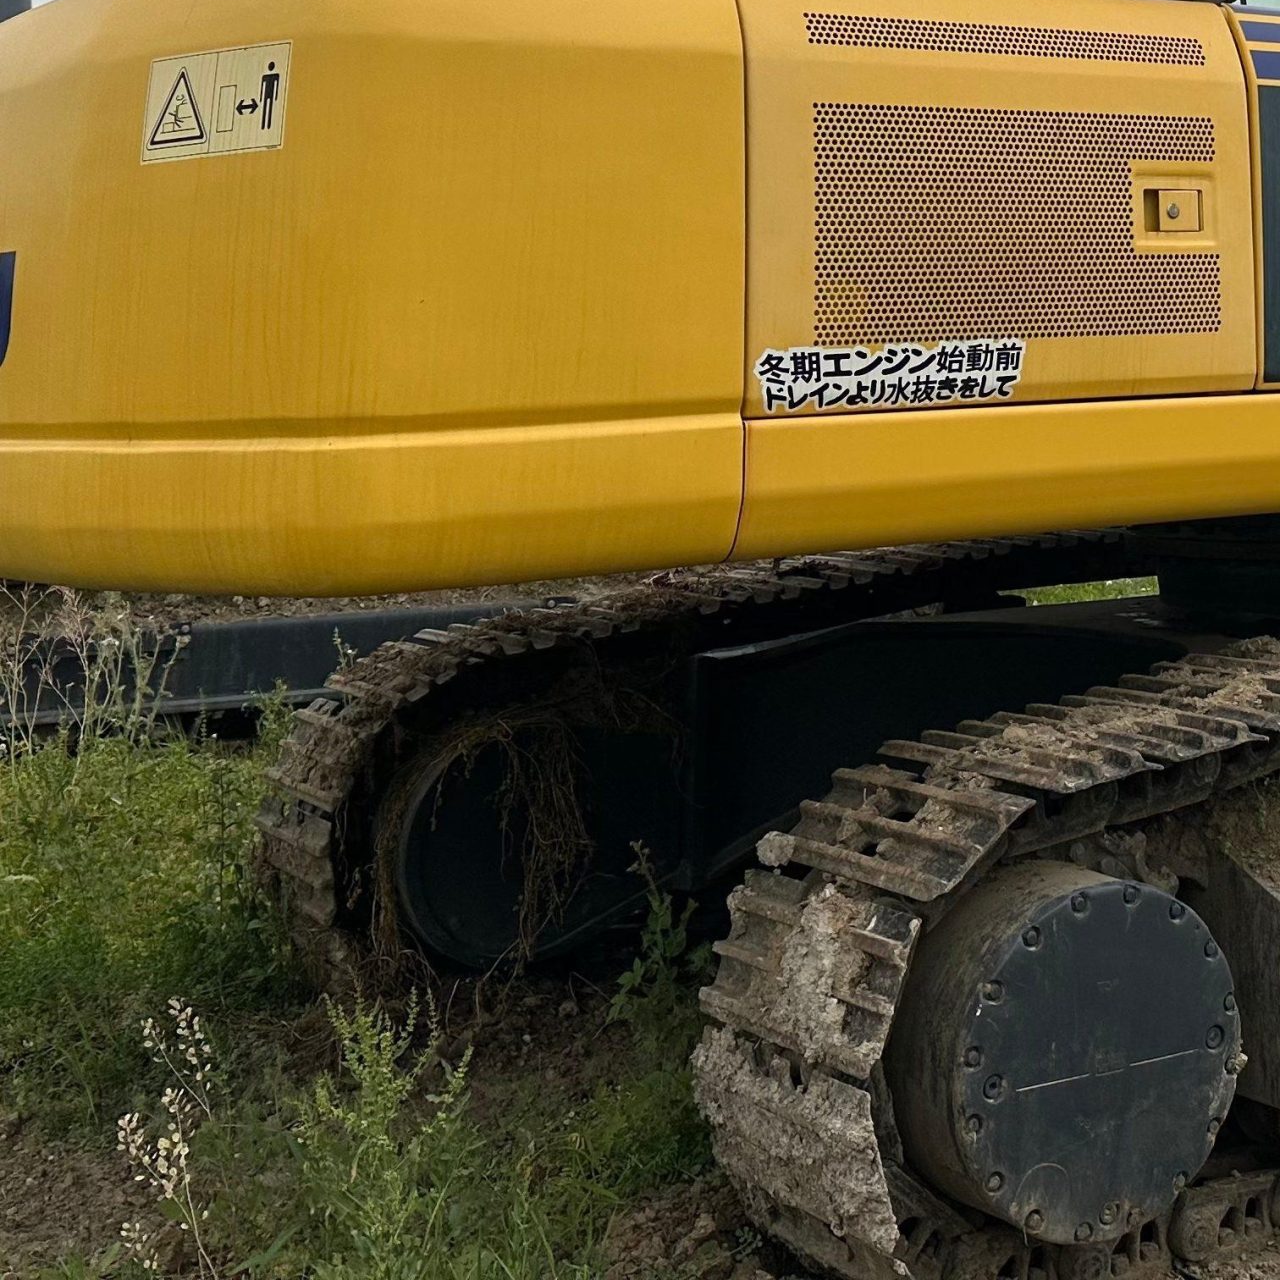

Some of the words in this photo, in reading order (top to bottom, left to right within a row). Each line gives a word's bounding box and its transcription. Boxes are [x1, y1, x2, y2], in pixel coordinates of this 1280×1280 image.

[758, 343, 1023, 384] 冬期エンジン始動前
[765, 375, 1018, 411] ドレインより水抜きをして
